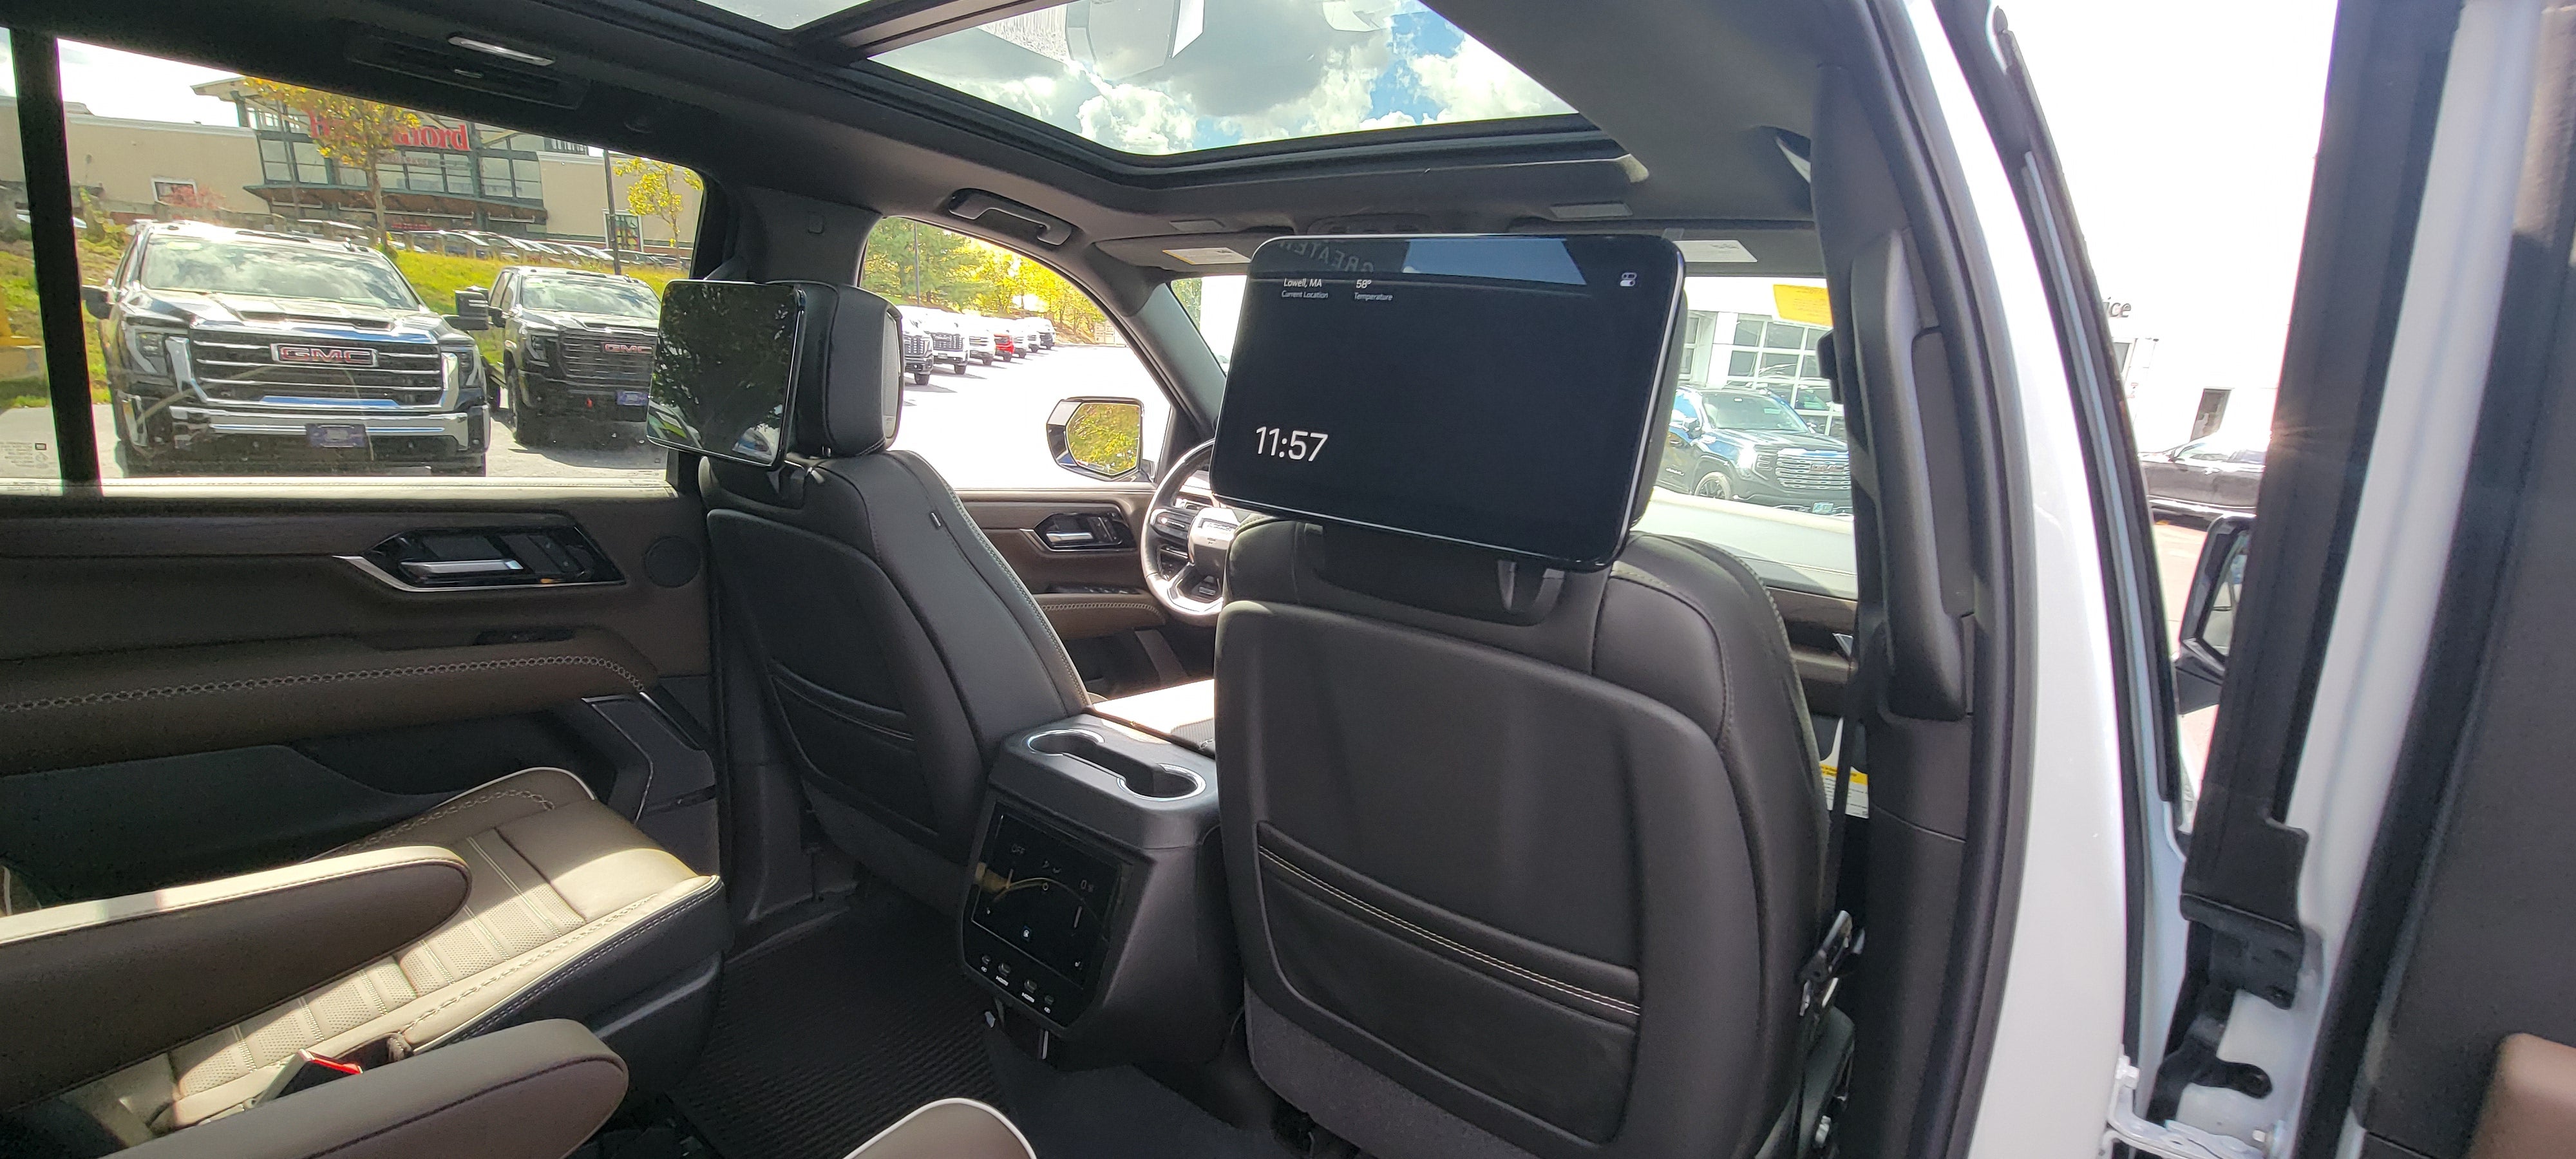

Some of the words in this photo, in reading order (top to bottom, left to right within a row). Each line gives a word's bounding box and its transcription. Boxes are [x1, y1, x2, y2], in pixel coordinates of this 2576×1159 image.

[1283, 278, 1307, 288] Lowell,
[1309, 279, 1322, 288] MA
[1354, 292, 1393, 301] Temperature
[280, 346, 372, 364] GMC
[605, 344, 652, 355] GMC
[1256, 426, 1329, 462] 11:57
